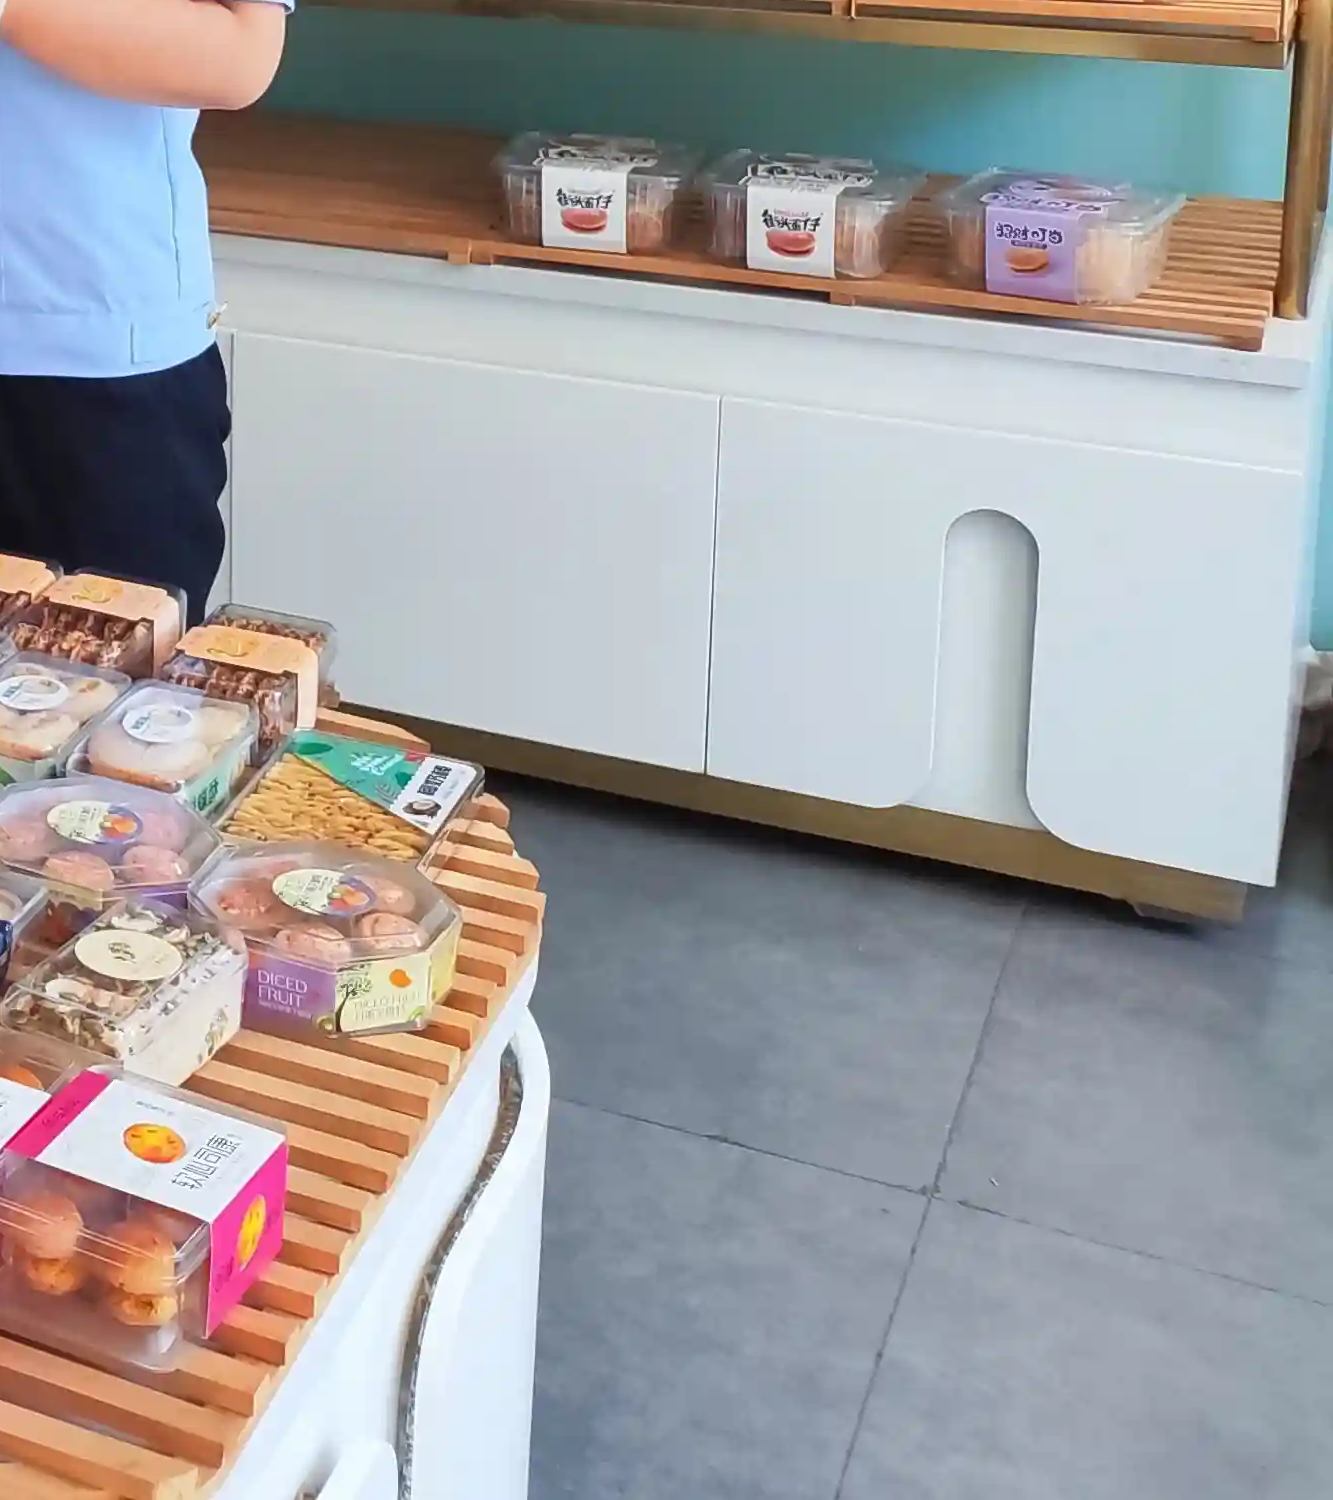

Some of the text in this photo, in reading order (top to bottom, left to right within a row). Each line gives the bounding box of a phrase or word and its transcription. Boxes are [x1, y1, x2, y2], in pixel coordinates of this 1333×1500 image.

[257, 969, 308, 994] DICED
[257, 984, 305, 1008] FRUIT
[171, 1132, 240, 1190] 软心司康
